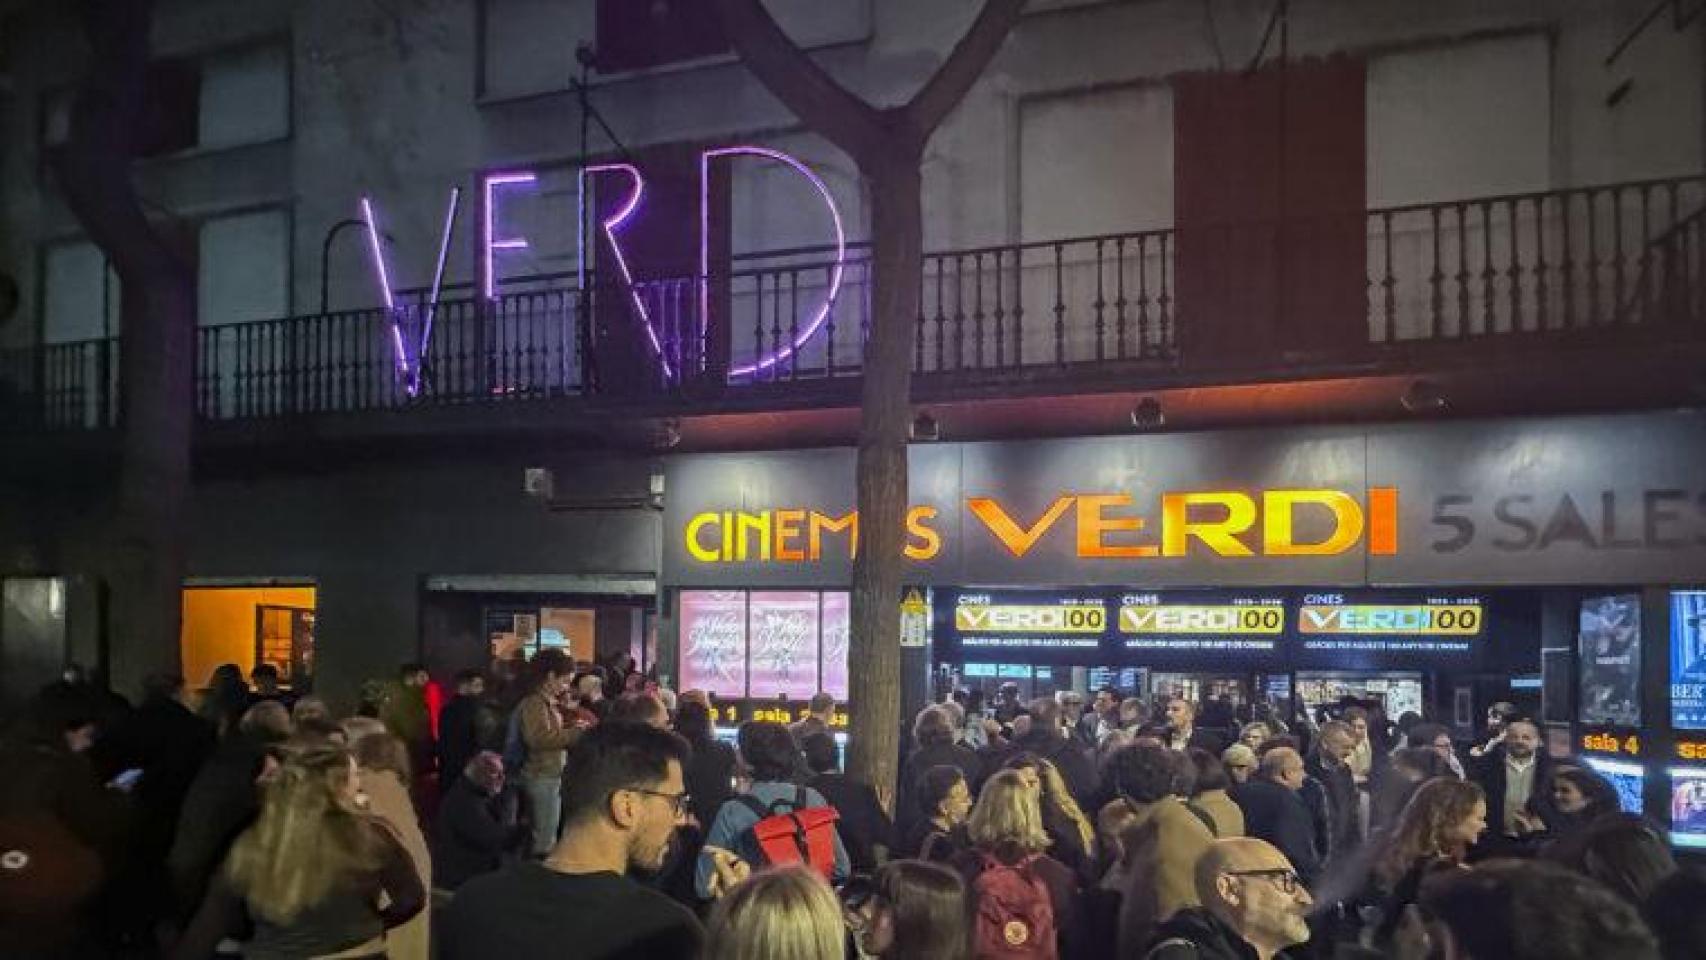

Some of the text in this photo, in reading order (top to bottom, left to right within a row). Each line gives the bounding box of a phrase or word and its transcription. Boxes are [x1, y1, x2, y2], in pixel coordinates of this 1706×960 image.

[686, 487, 1706, 562] CINEMS VERDI 5 SALE
[1303, 594, 1343, 604] CINES
[1583, 733, 1639, 754] sala 4
